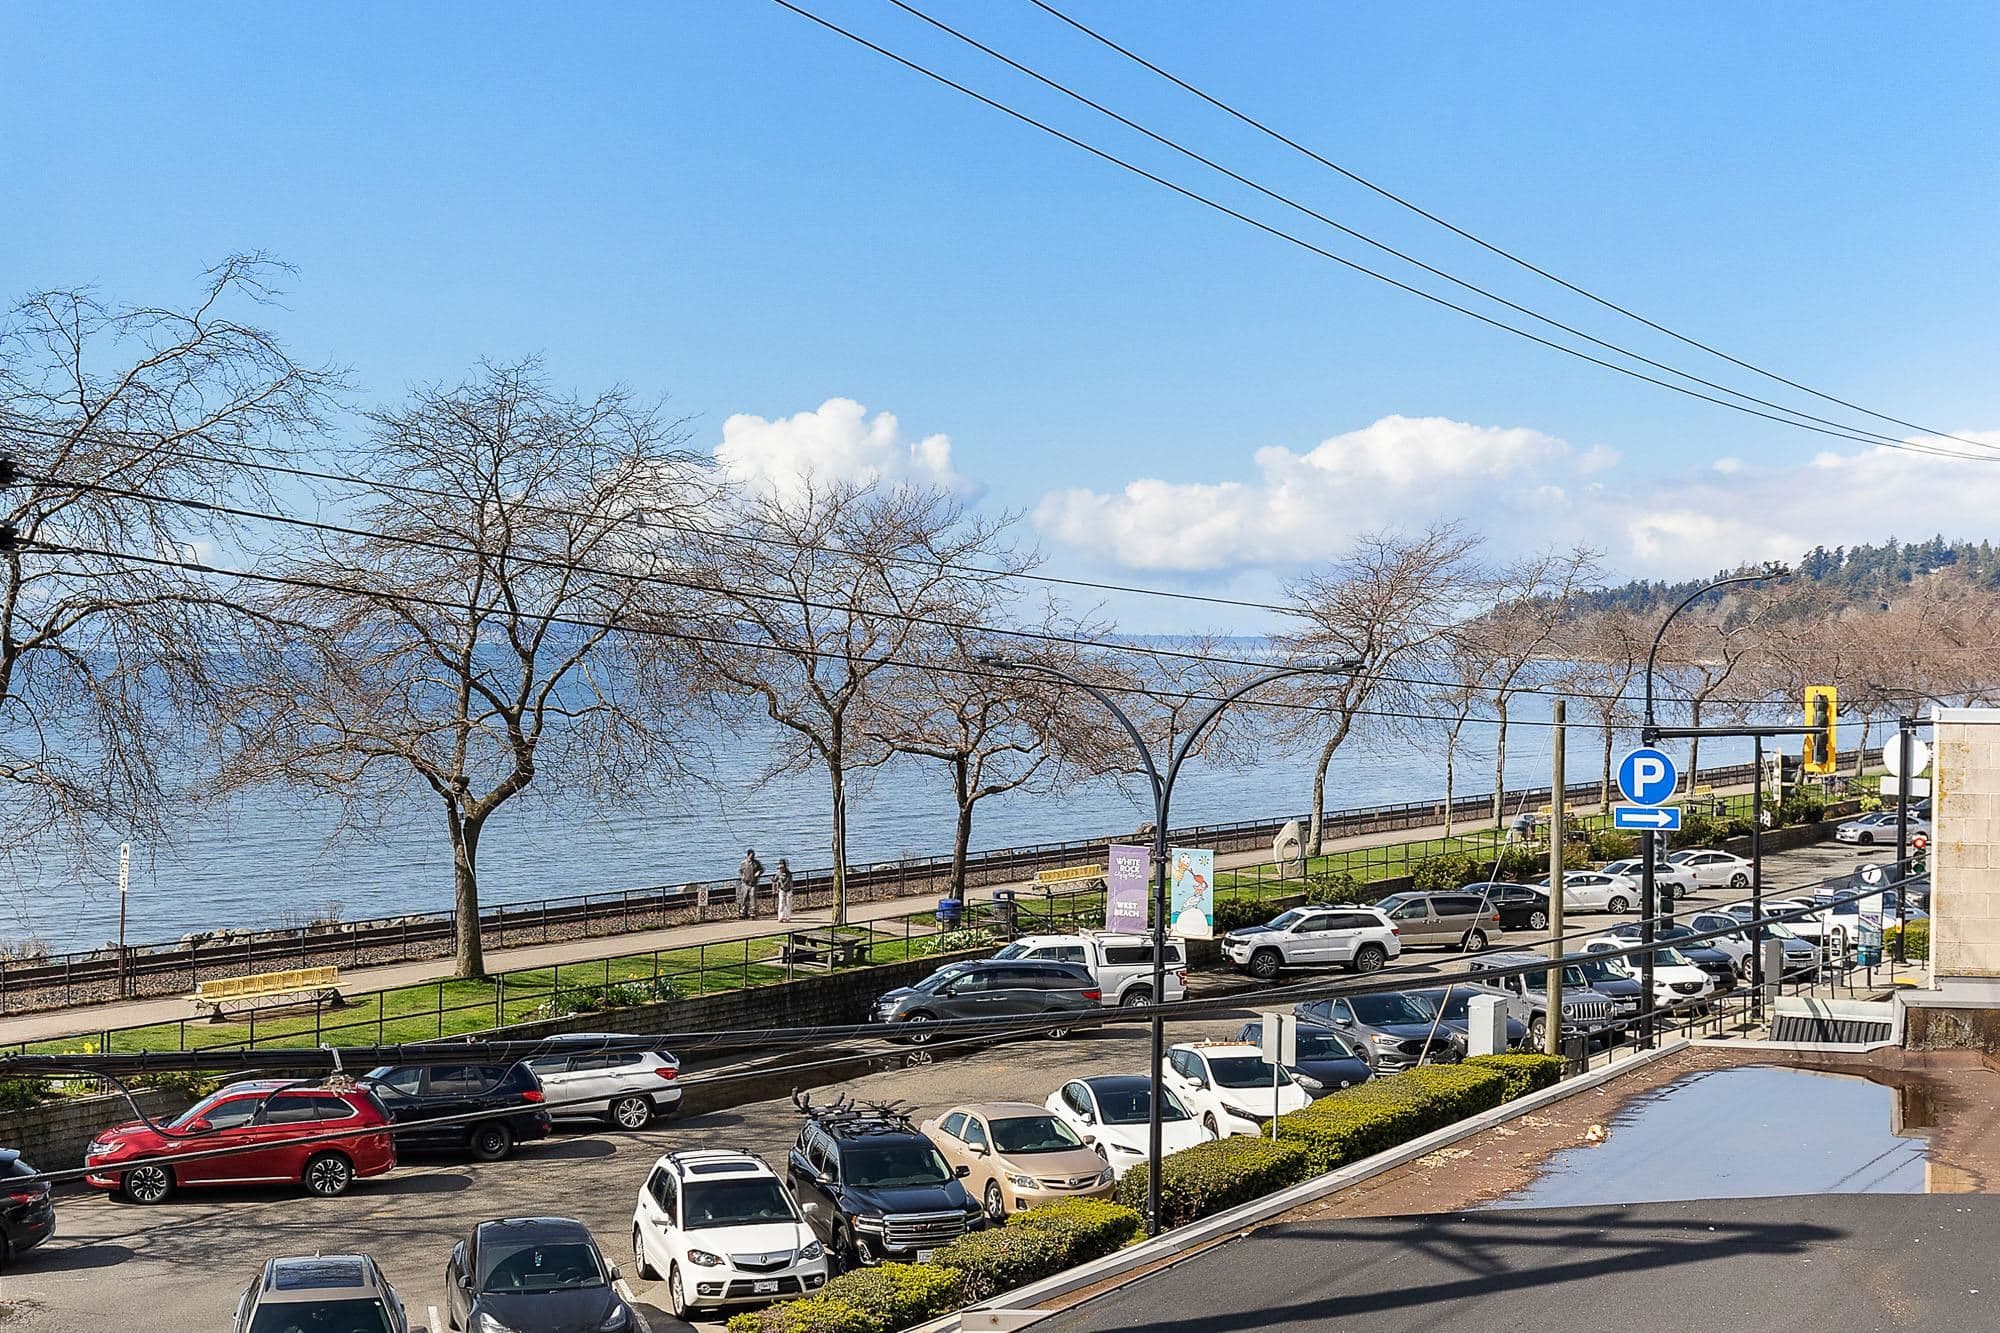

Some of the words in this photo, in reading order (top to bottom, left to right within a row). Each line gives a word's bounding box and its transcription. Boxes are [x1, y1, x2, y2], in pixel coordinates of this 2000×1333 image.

[1633, 758, 1665, 797] P
[1116, 857, 1141, 866] WHITE
[1119, 865, 1140, 873] ROCK
[1113, 909, 1140, 918] BEACH
